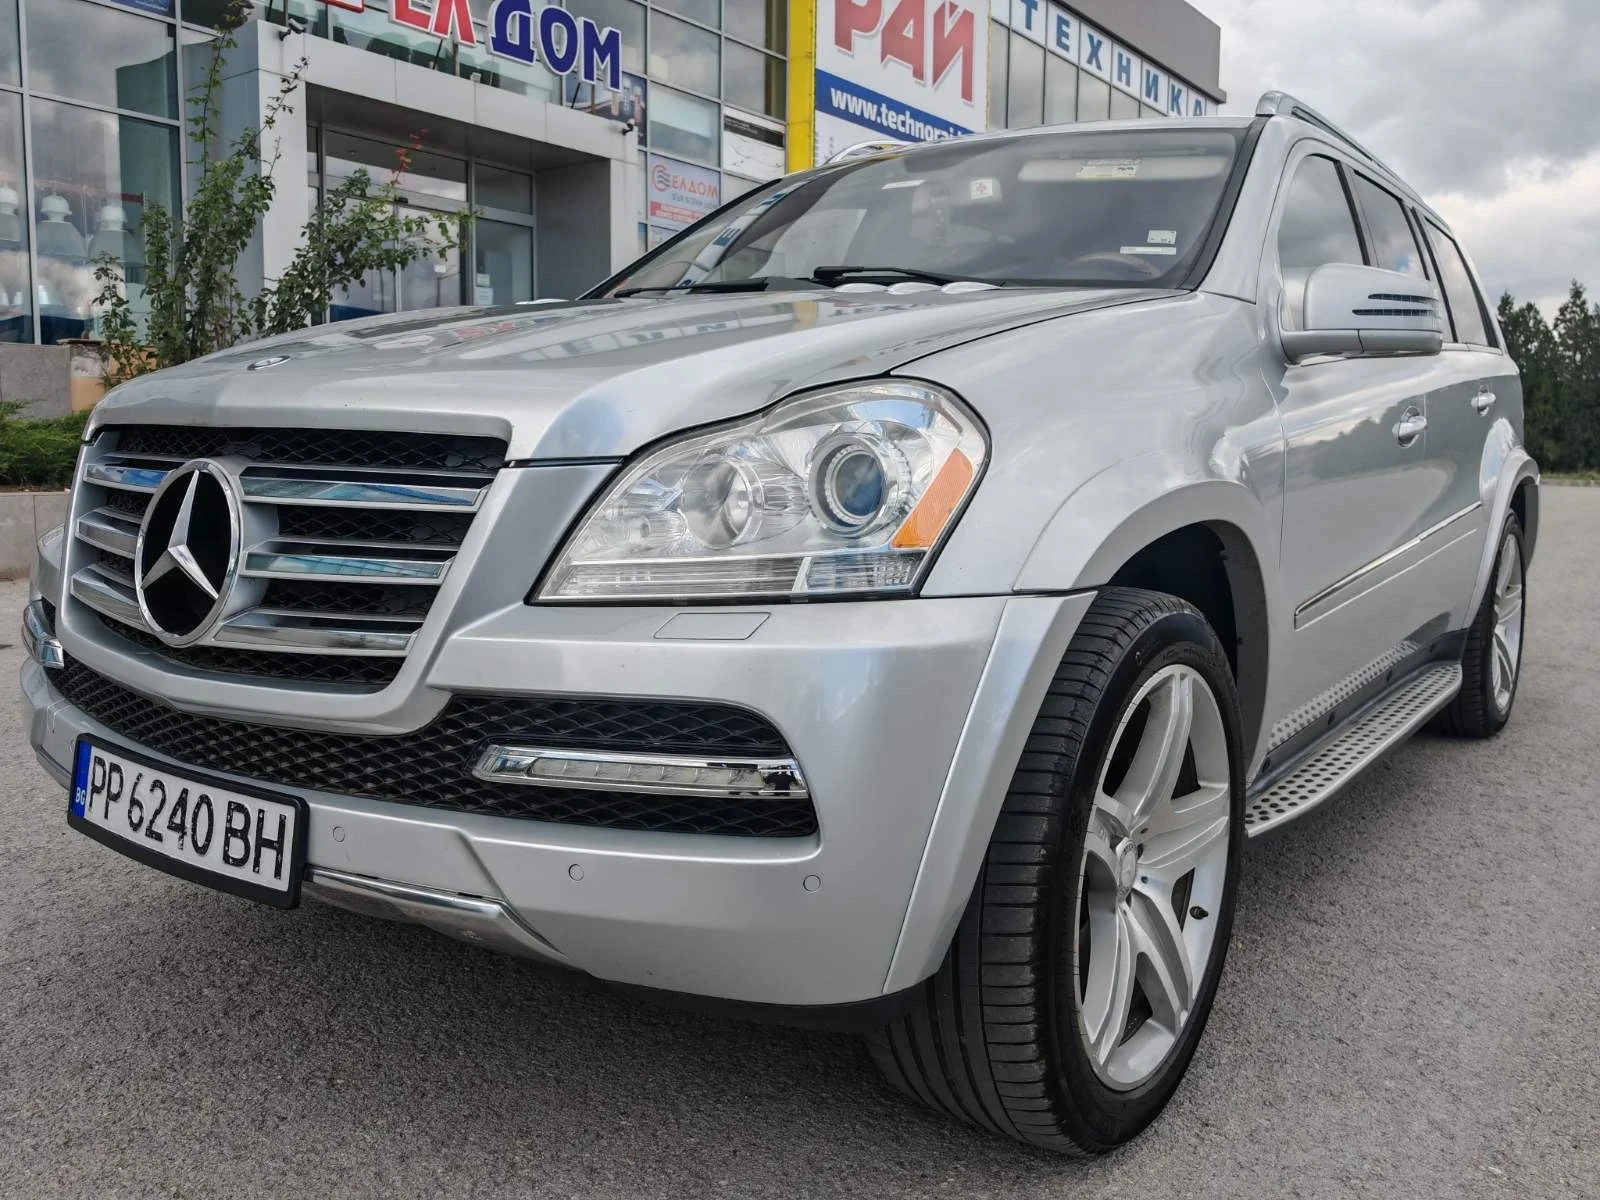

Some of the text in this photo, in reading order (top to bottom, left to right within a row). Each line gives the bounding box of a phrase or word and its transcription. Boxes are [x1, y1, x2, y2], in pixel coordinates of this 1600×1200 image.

[1021, 0, 1203, 116] ТЕХНИКА
[76, 786, 86, 806] BG
[127, 773, 214, 856] 6240
